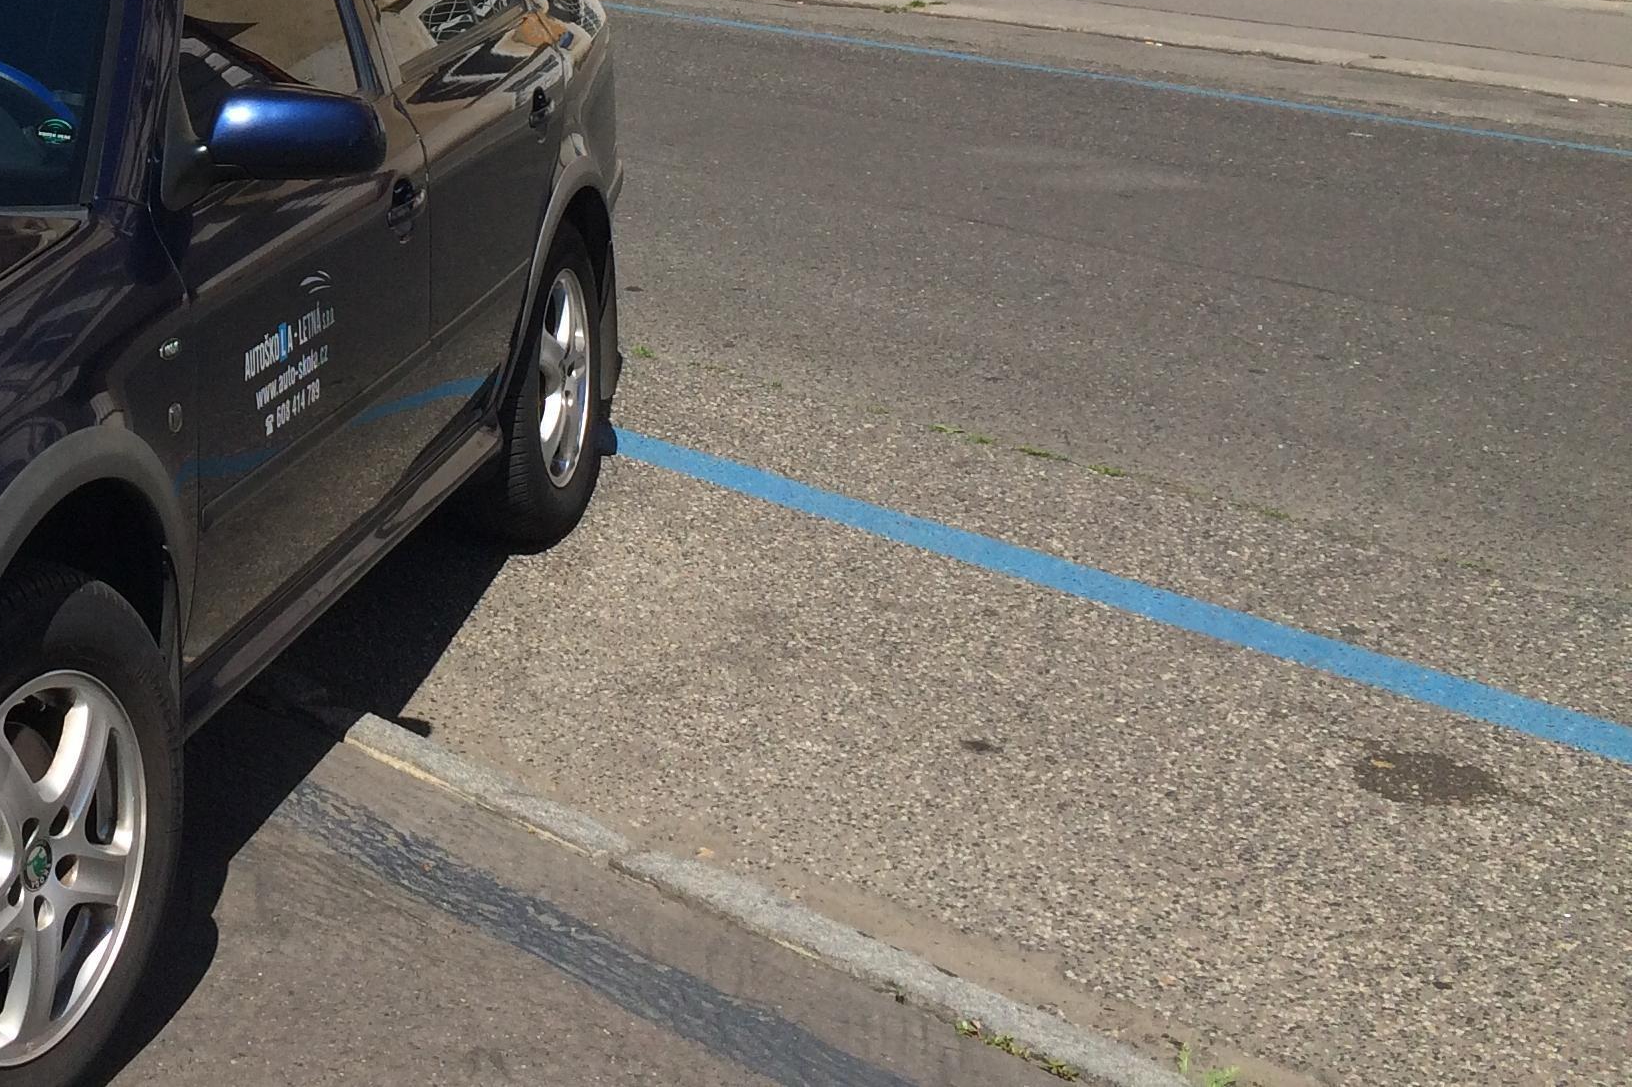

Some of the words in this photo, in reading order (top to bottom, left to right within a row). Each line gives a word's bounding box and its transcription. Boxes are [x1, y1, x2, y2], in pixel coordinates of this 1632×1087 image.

[244, 322, 294, 382] AUTOŠKOLA
[297, 300, 322, 346] LETNÁ
[291, 388, 305, 416] 414
